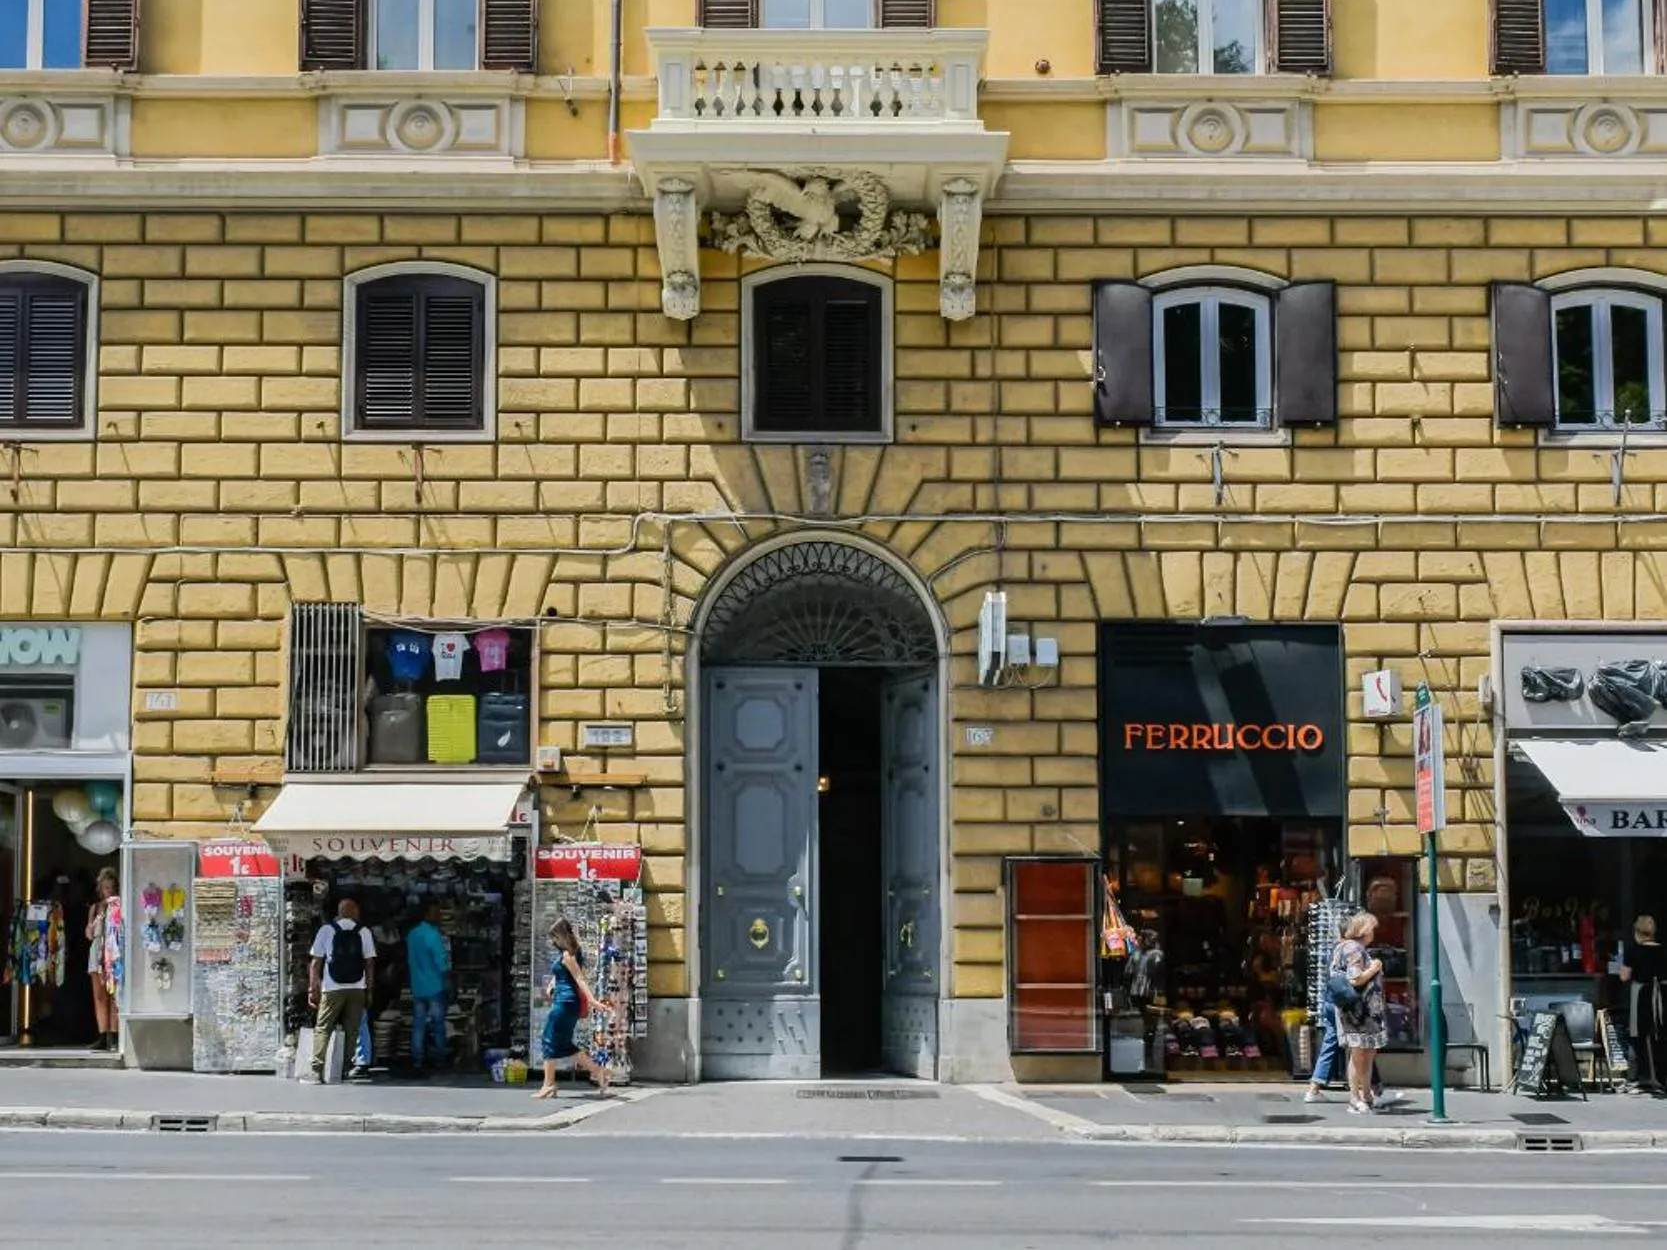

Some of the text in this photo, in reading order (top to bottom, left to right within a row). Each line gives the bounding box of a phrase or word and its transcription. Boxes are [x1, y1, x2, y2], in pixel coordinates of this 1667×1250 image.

[1123, 723, 1324, 750] FERRUCCIO
[312, 837, 456, 852] SOUVENIR
[537, 849, 636, 860] SOUVENIR
